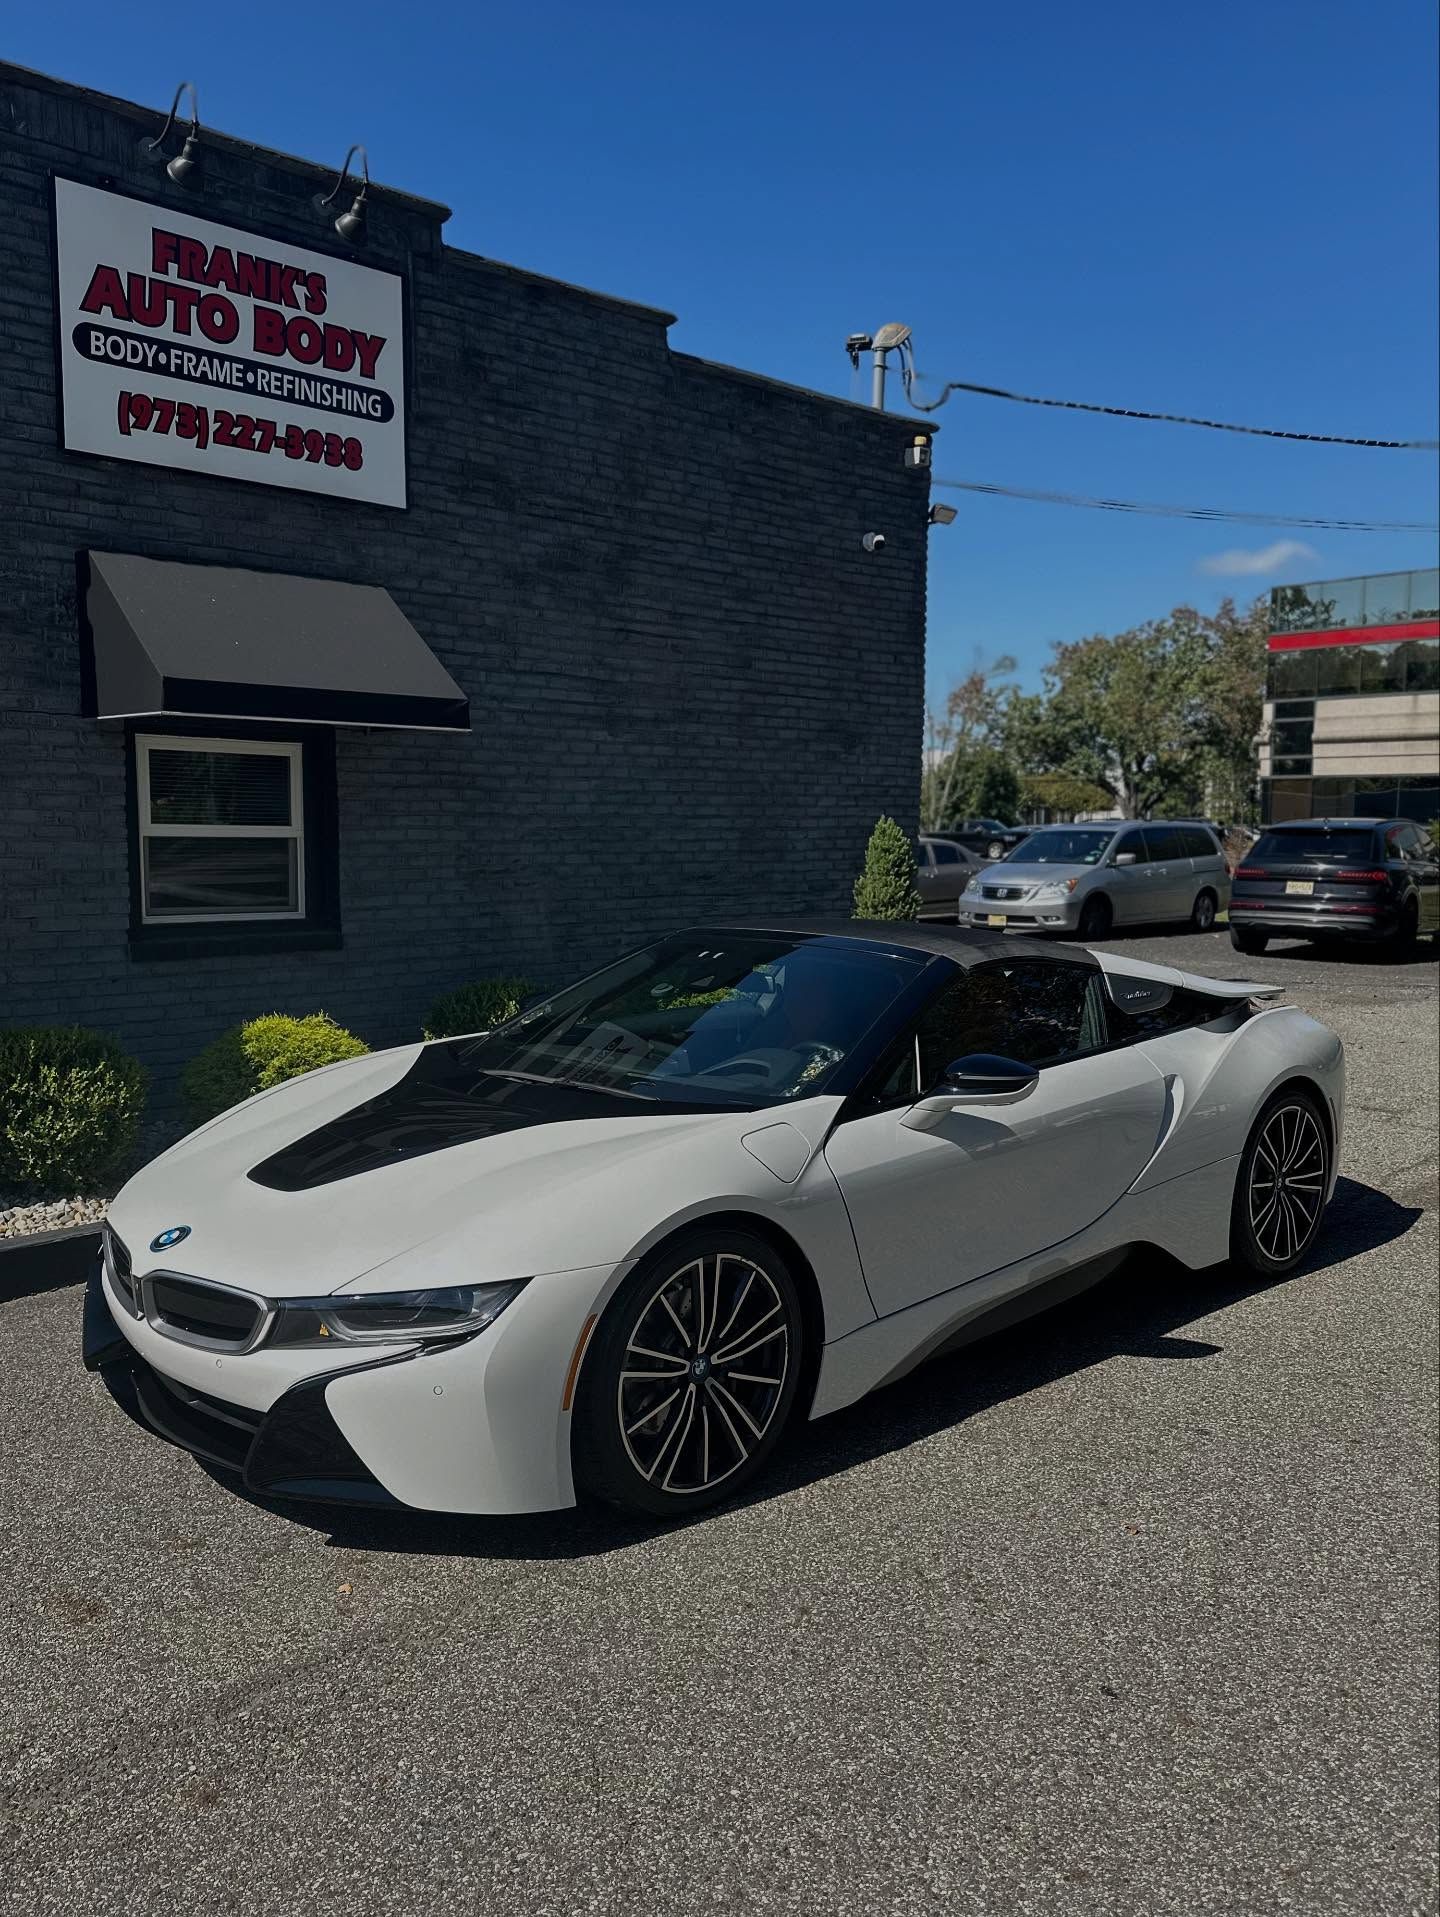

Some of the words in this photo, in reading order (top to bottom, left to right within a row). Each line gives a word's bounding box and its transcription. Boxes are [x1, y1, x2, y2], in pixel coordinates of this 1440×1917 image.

[152, 227, 327, 315] FRANK'S
[79, 264, 240, 344] AUTO
[253, 304, 387, 380] BODY
[90, 331, 158, 367] BODY
[170, 349, 243, 387] FRAME
[257, 369, 382, 417] REFINISHING
[117, 390, 210, 450] (973)
[212, 410, 363, 471] 227-3938
